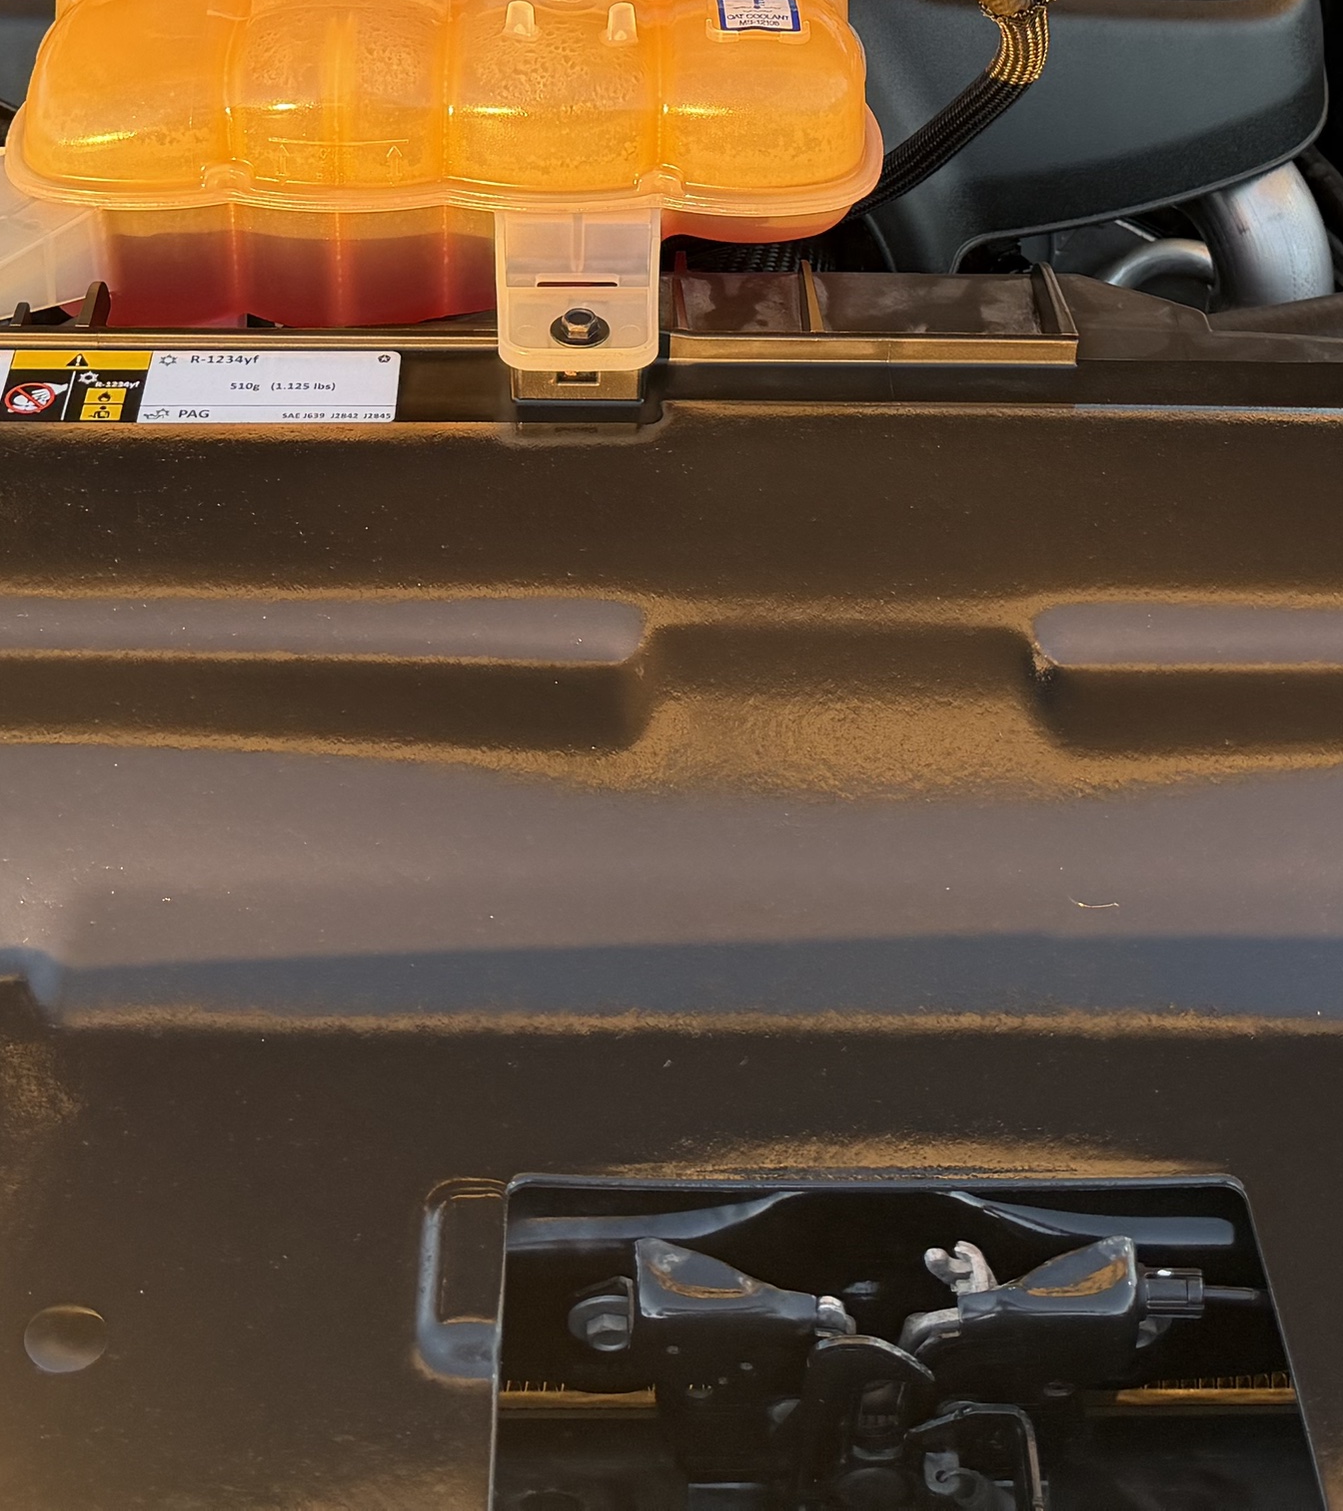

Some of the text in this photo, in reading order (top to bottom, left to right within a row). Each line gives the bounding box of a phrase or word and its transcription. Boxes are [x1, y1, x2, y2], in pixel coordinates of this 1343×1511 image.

[746, 13, 790, 21] COOLANT
[190, 354, 260, 366] R-1234yf
[229, 381, 337, 392] 510g (1.125 lbs)
[178, 409, 210, 419] PAG
[282, 412, 392, 420] SAE J639 J2842 J2845
